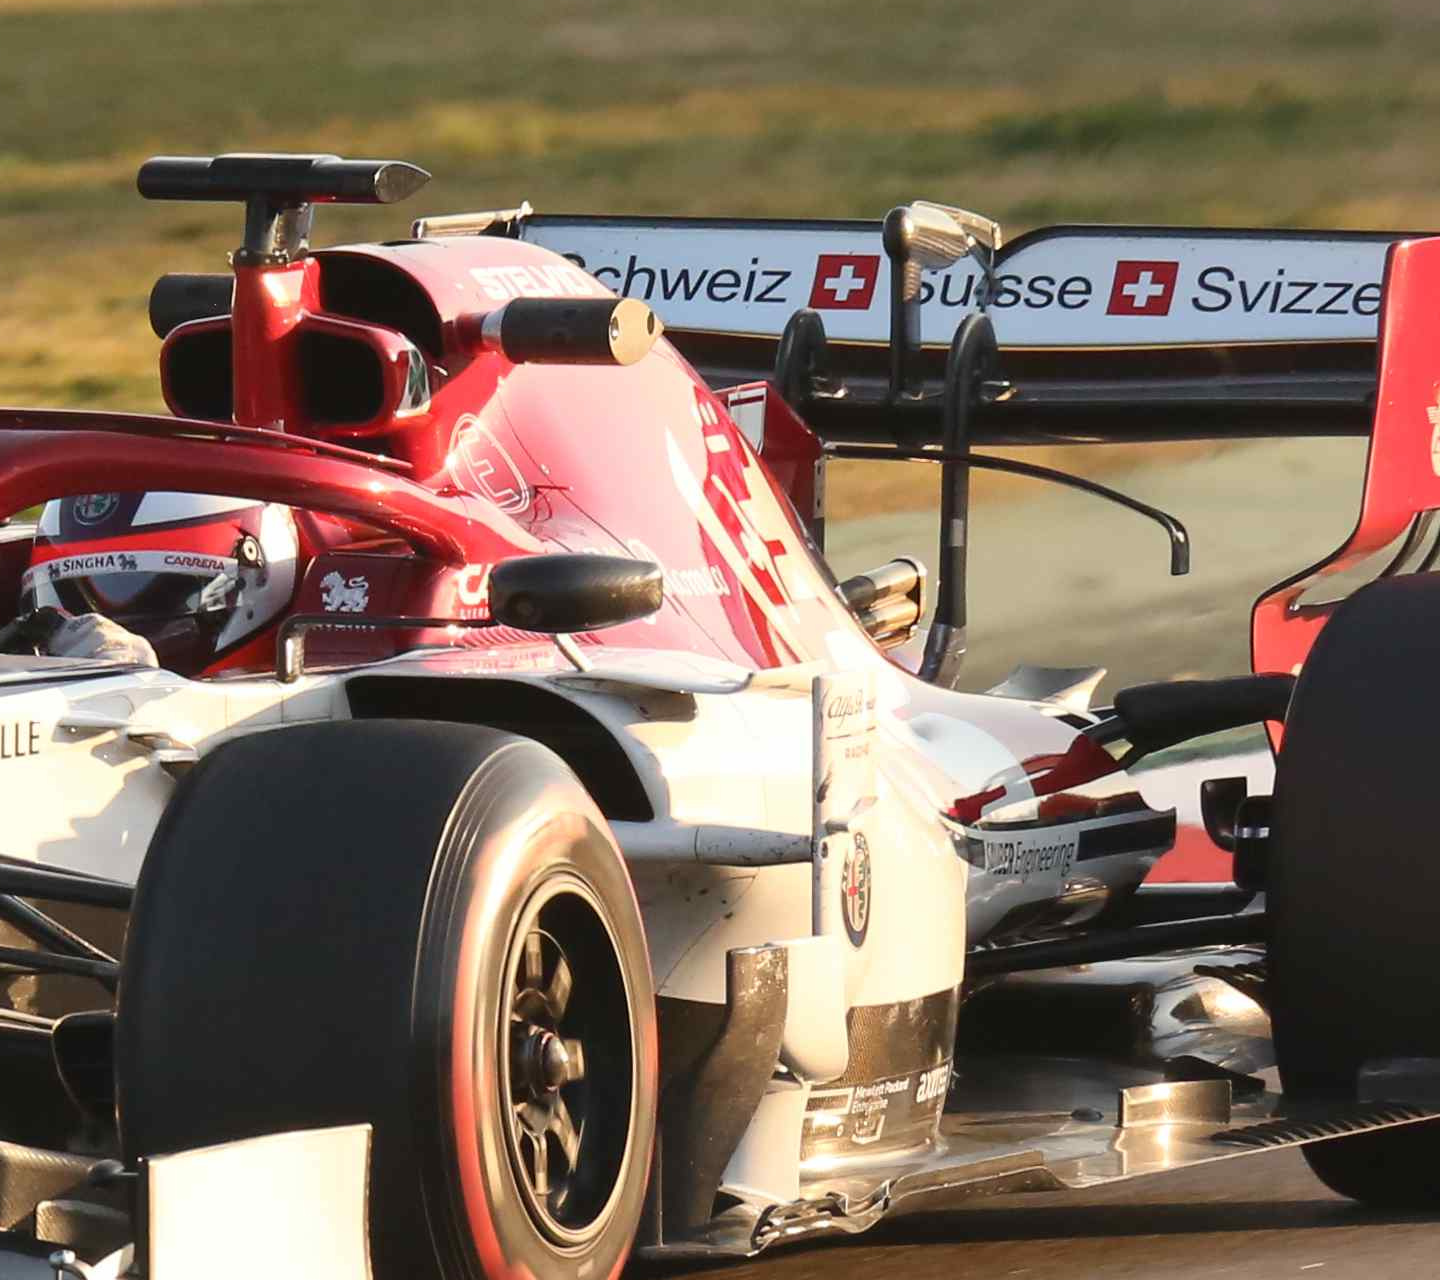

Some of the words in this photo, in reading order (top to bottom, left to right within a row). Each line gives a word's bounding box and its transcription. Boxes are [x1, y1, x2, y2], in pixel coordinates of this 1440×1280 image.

[1191, 266, 1384, 316] Svizze
[62, 554, 115, 572] SINGHA
[163, 554, 225, 571] CARRERA
